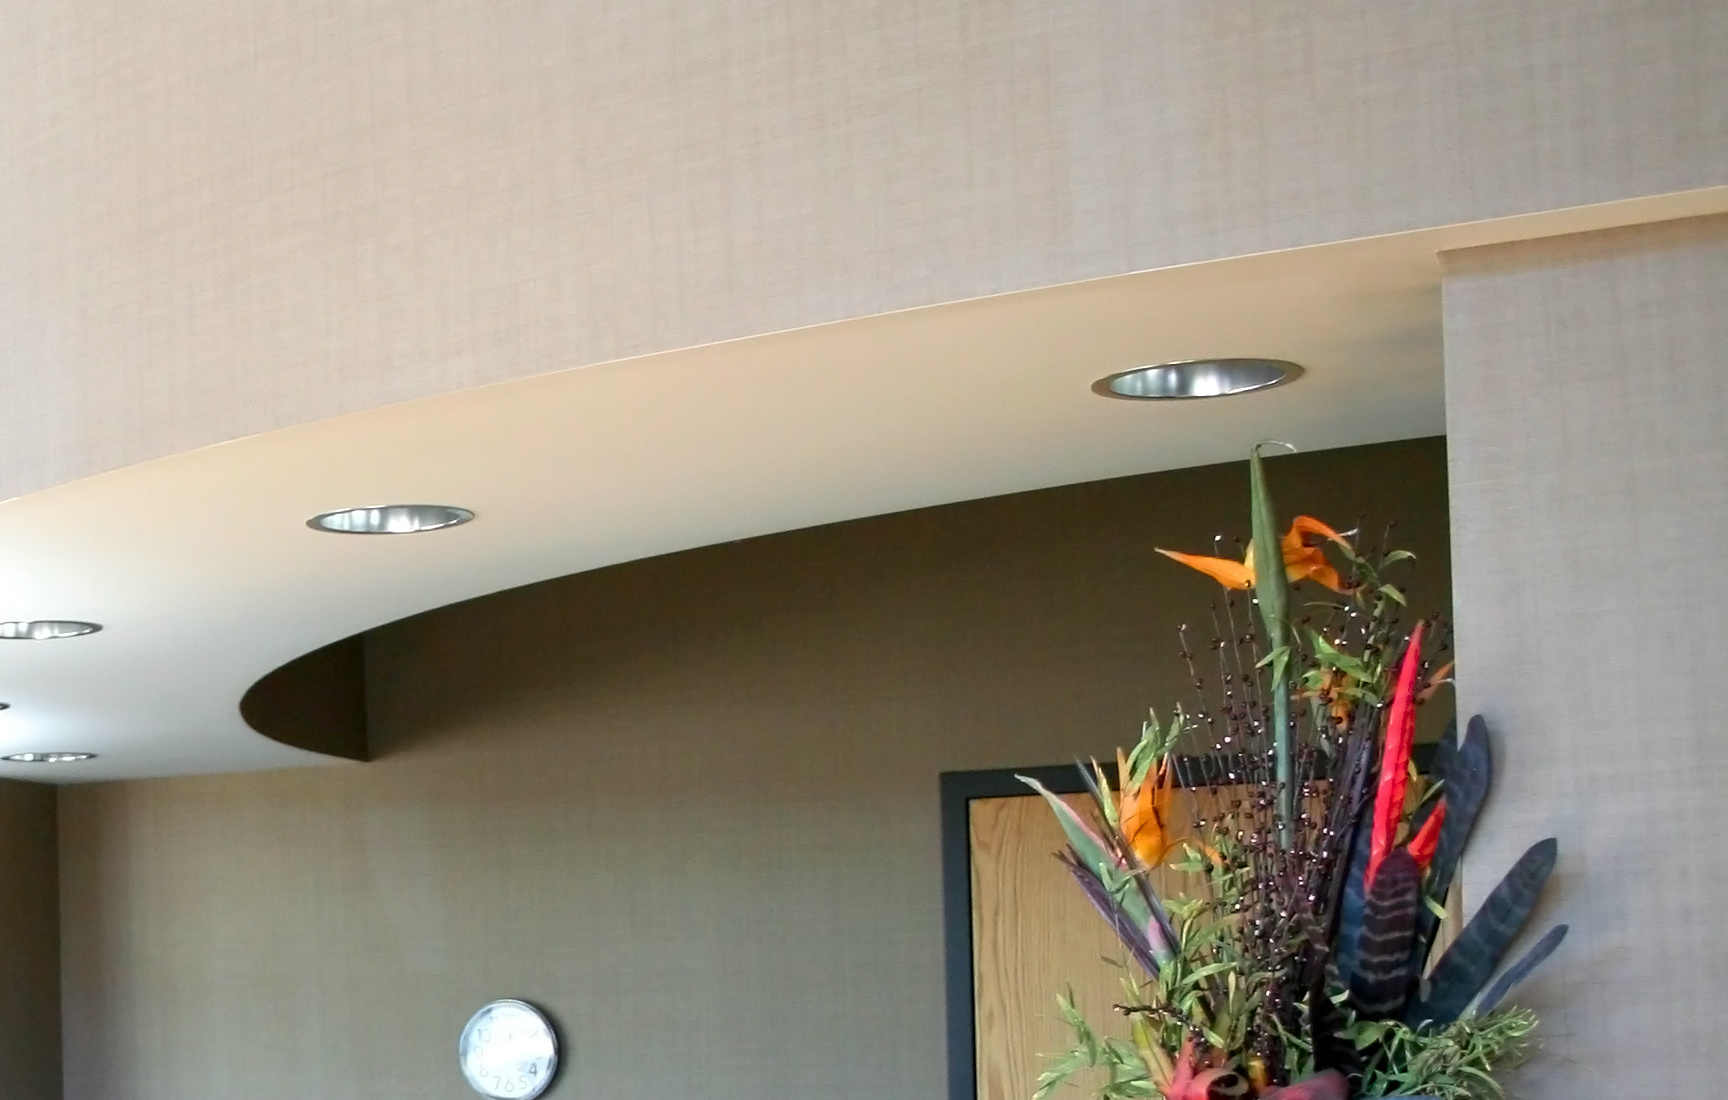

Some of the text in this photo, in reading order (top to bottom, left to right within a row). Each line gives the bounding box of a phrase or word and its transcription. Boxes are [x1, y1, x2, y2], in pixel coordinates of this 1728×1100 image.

[477, 1028, 492, 1043] 10
[473, 1045, 484, 1059] 9
[528, 1062, 539, 1077] 4
[492, 1075, 502, 1091] 7
[504, 1078, 515, 1093] 6
[518, 1075, 528, 1090] 5
